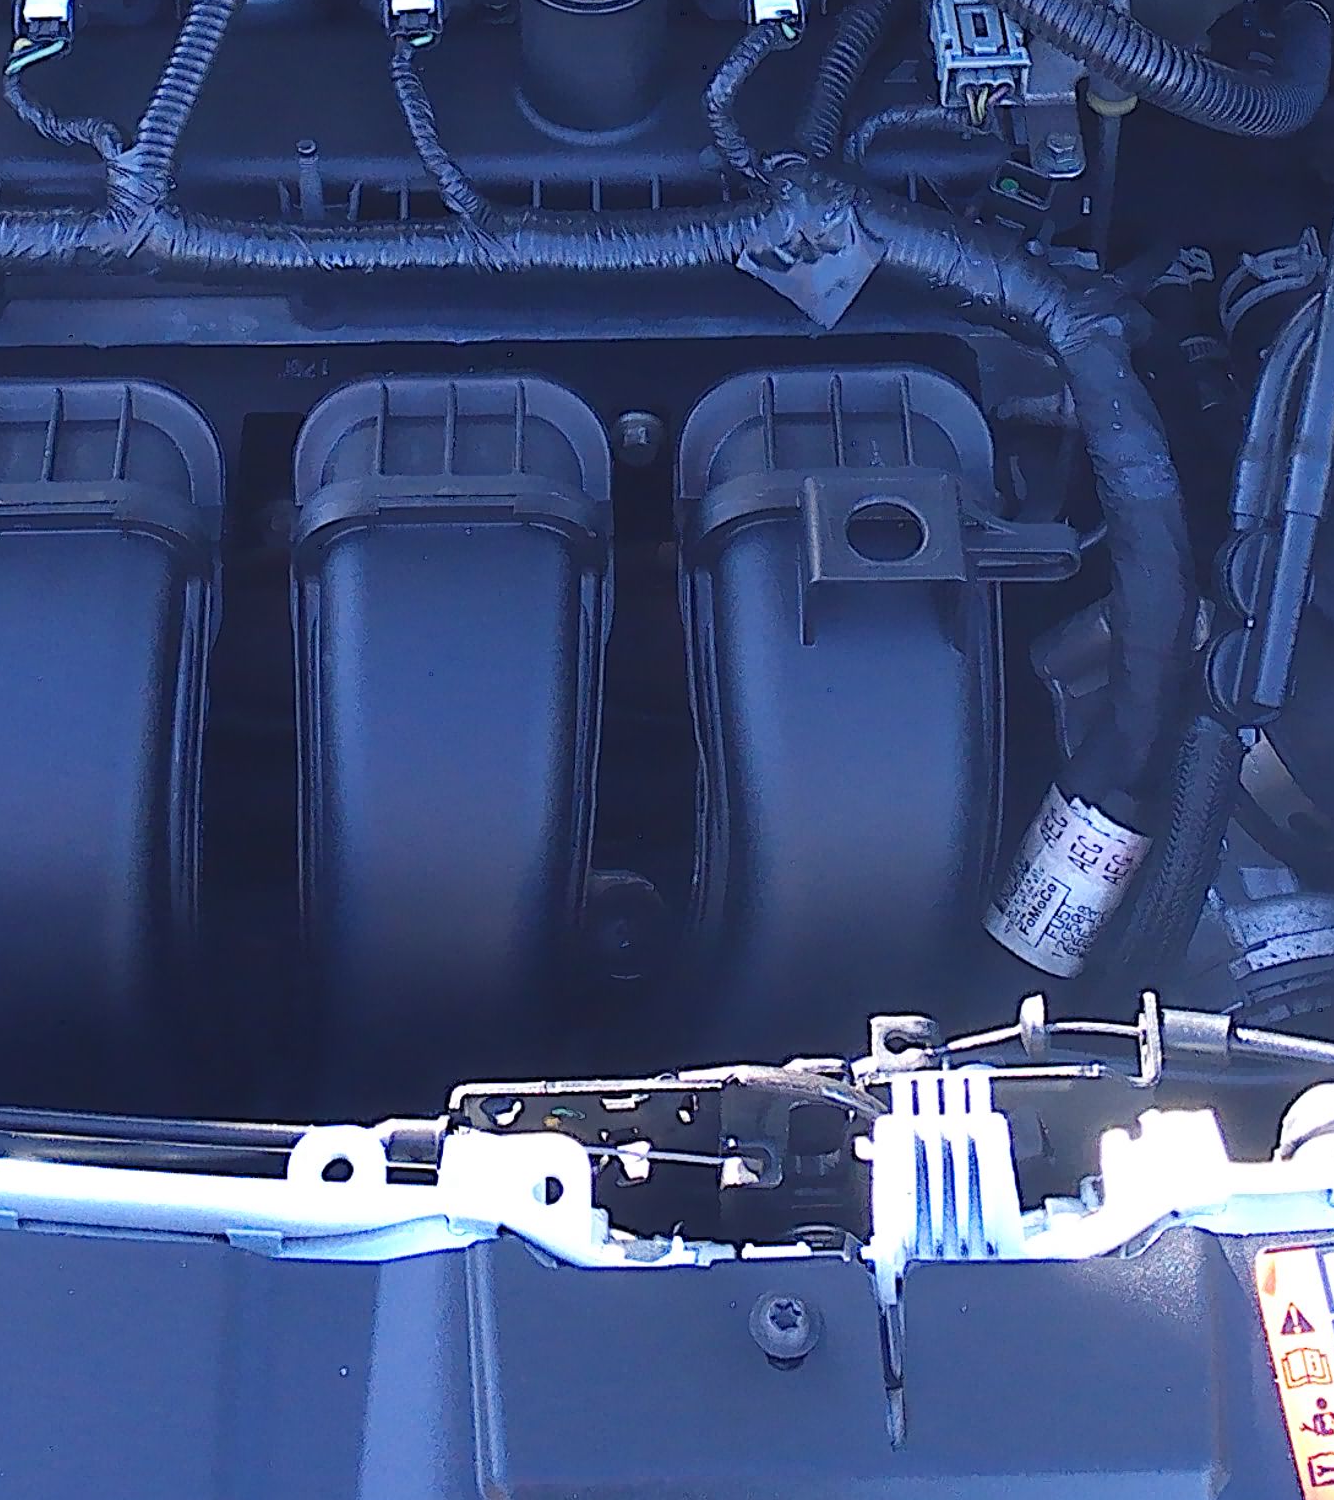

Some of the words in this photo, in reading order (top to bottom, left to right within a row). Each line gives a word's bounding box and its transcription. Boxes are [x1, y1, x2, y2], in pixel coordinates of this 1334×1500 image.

[1040, 807, 1069, 849] AEG
[1068, 835, 1104, 875] AEG
[1102, 853, 1133, 885] AEG
[1018, 883, 1058, 936] FoMoCo
